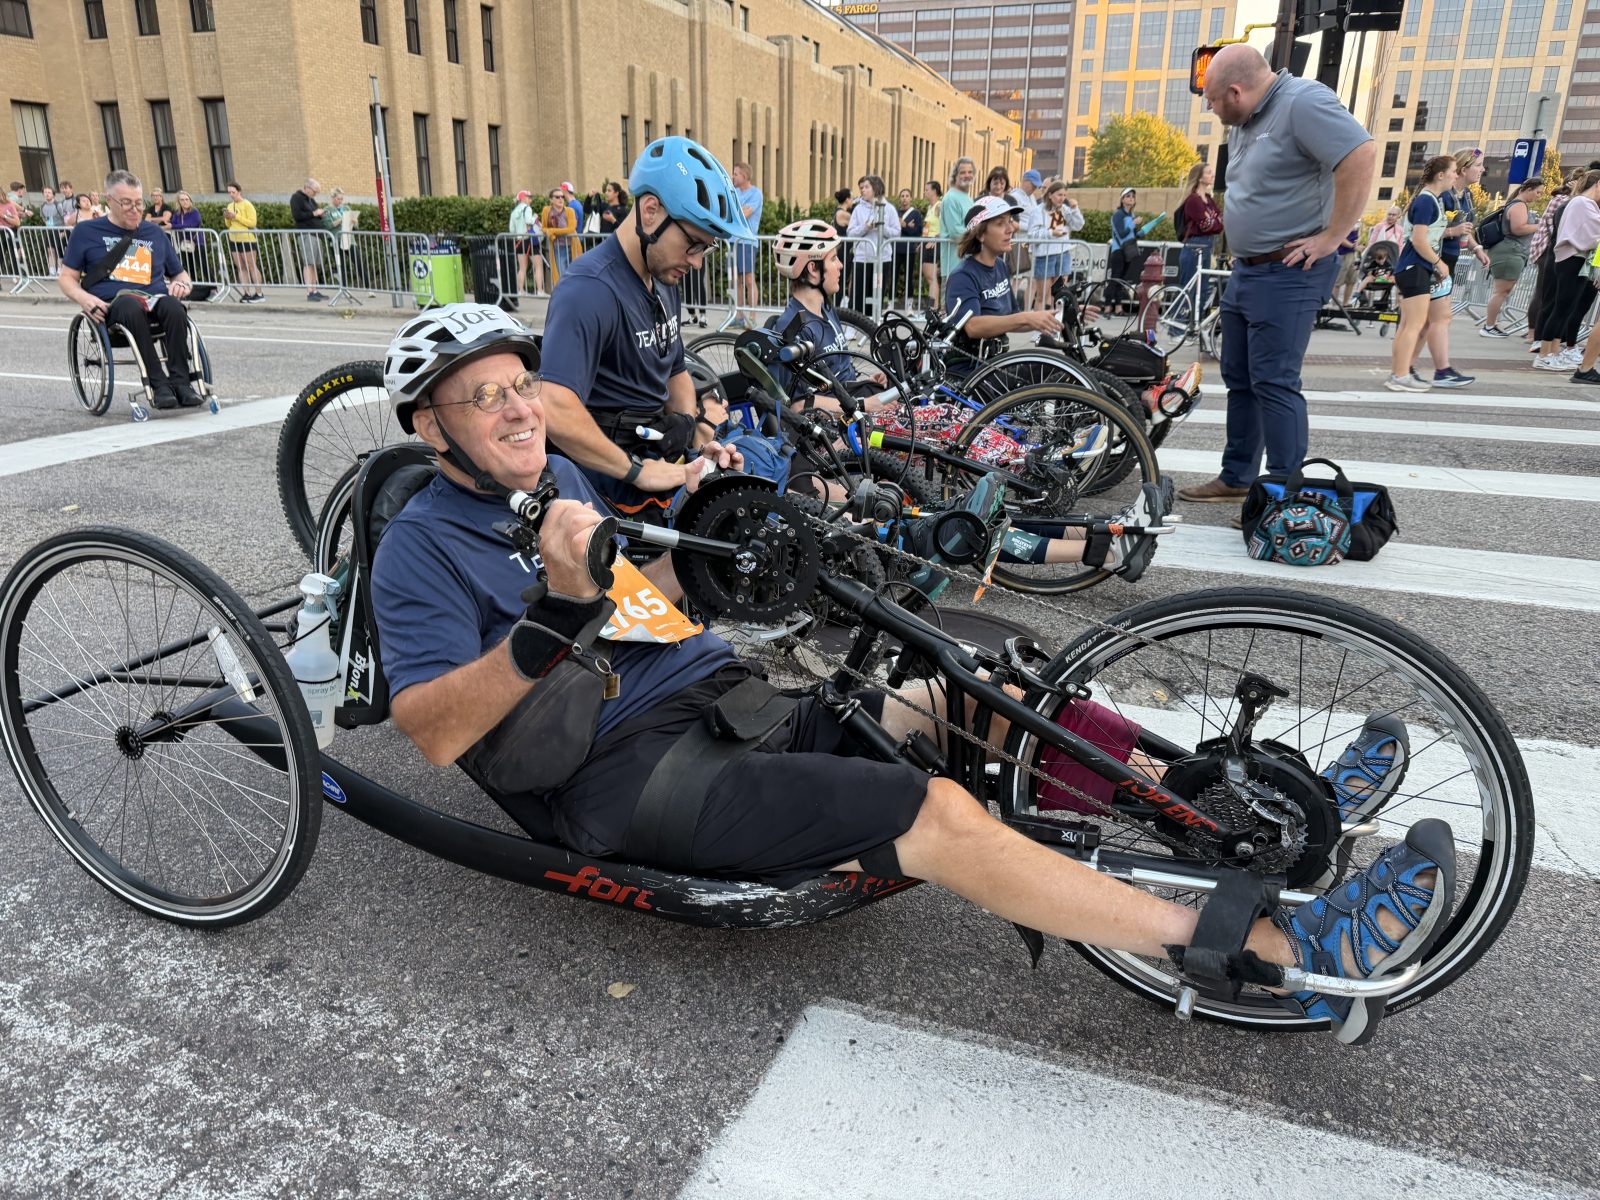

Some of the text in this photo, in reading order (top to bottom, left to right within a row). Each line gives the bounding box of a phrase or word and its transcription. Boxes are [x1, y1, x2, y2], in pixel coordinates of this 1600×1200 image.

[844, 3, 878, 14] FARGO
[115, 258, 150, 273] 444
[440, 309, 500, 335] JOE
[635, 327, 657, 349] TEA
[306, 375, 354, 406] MAXXIS
[509, 552, 545, 573] TE
